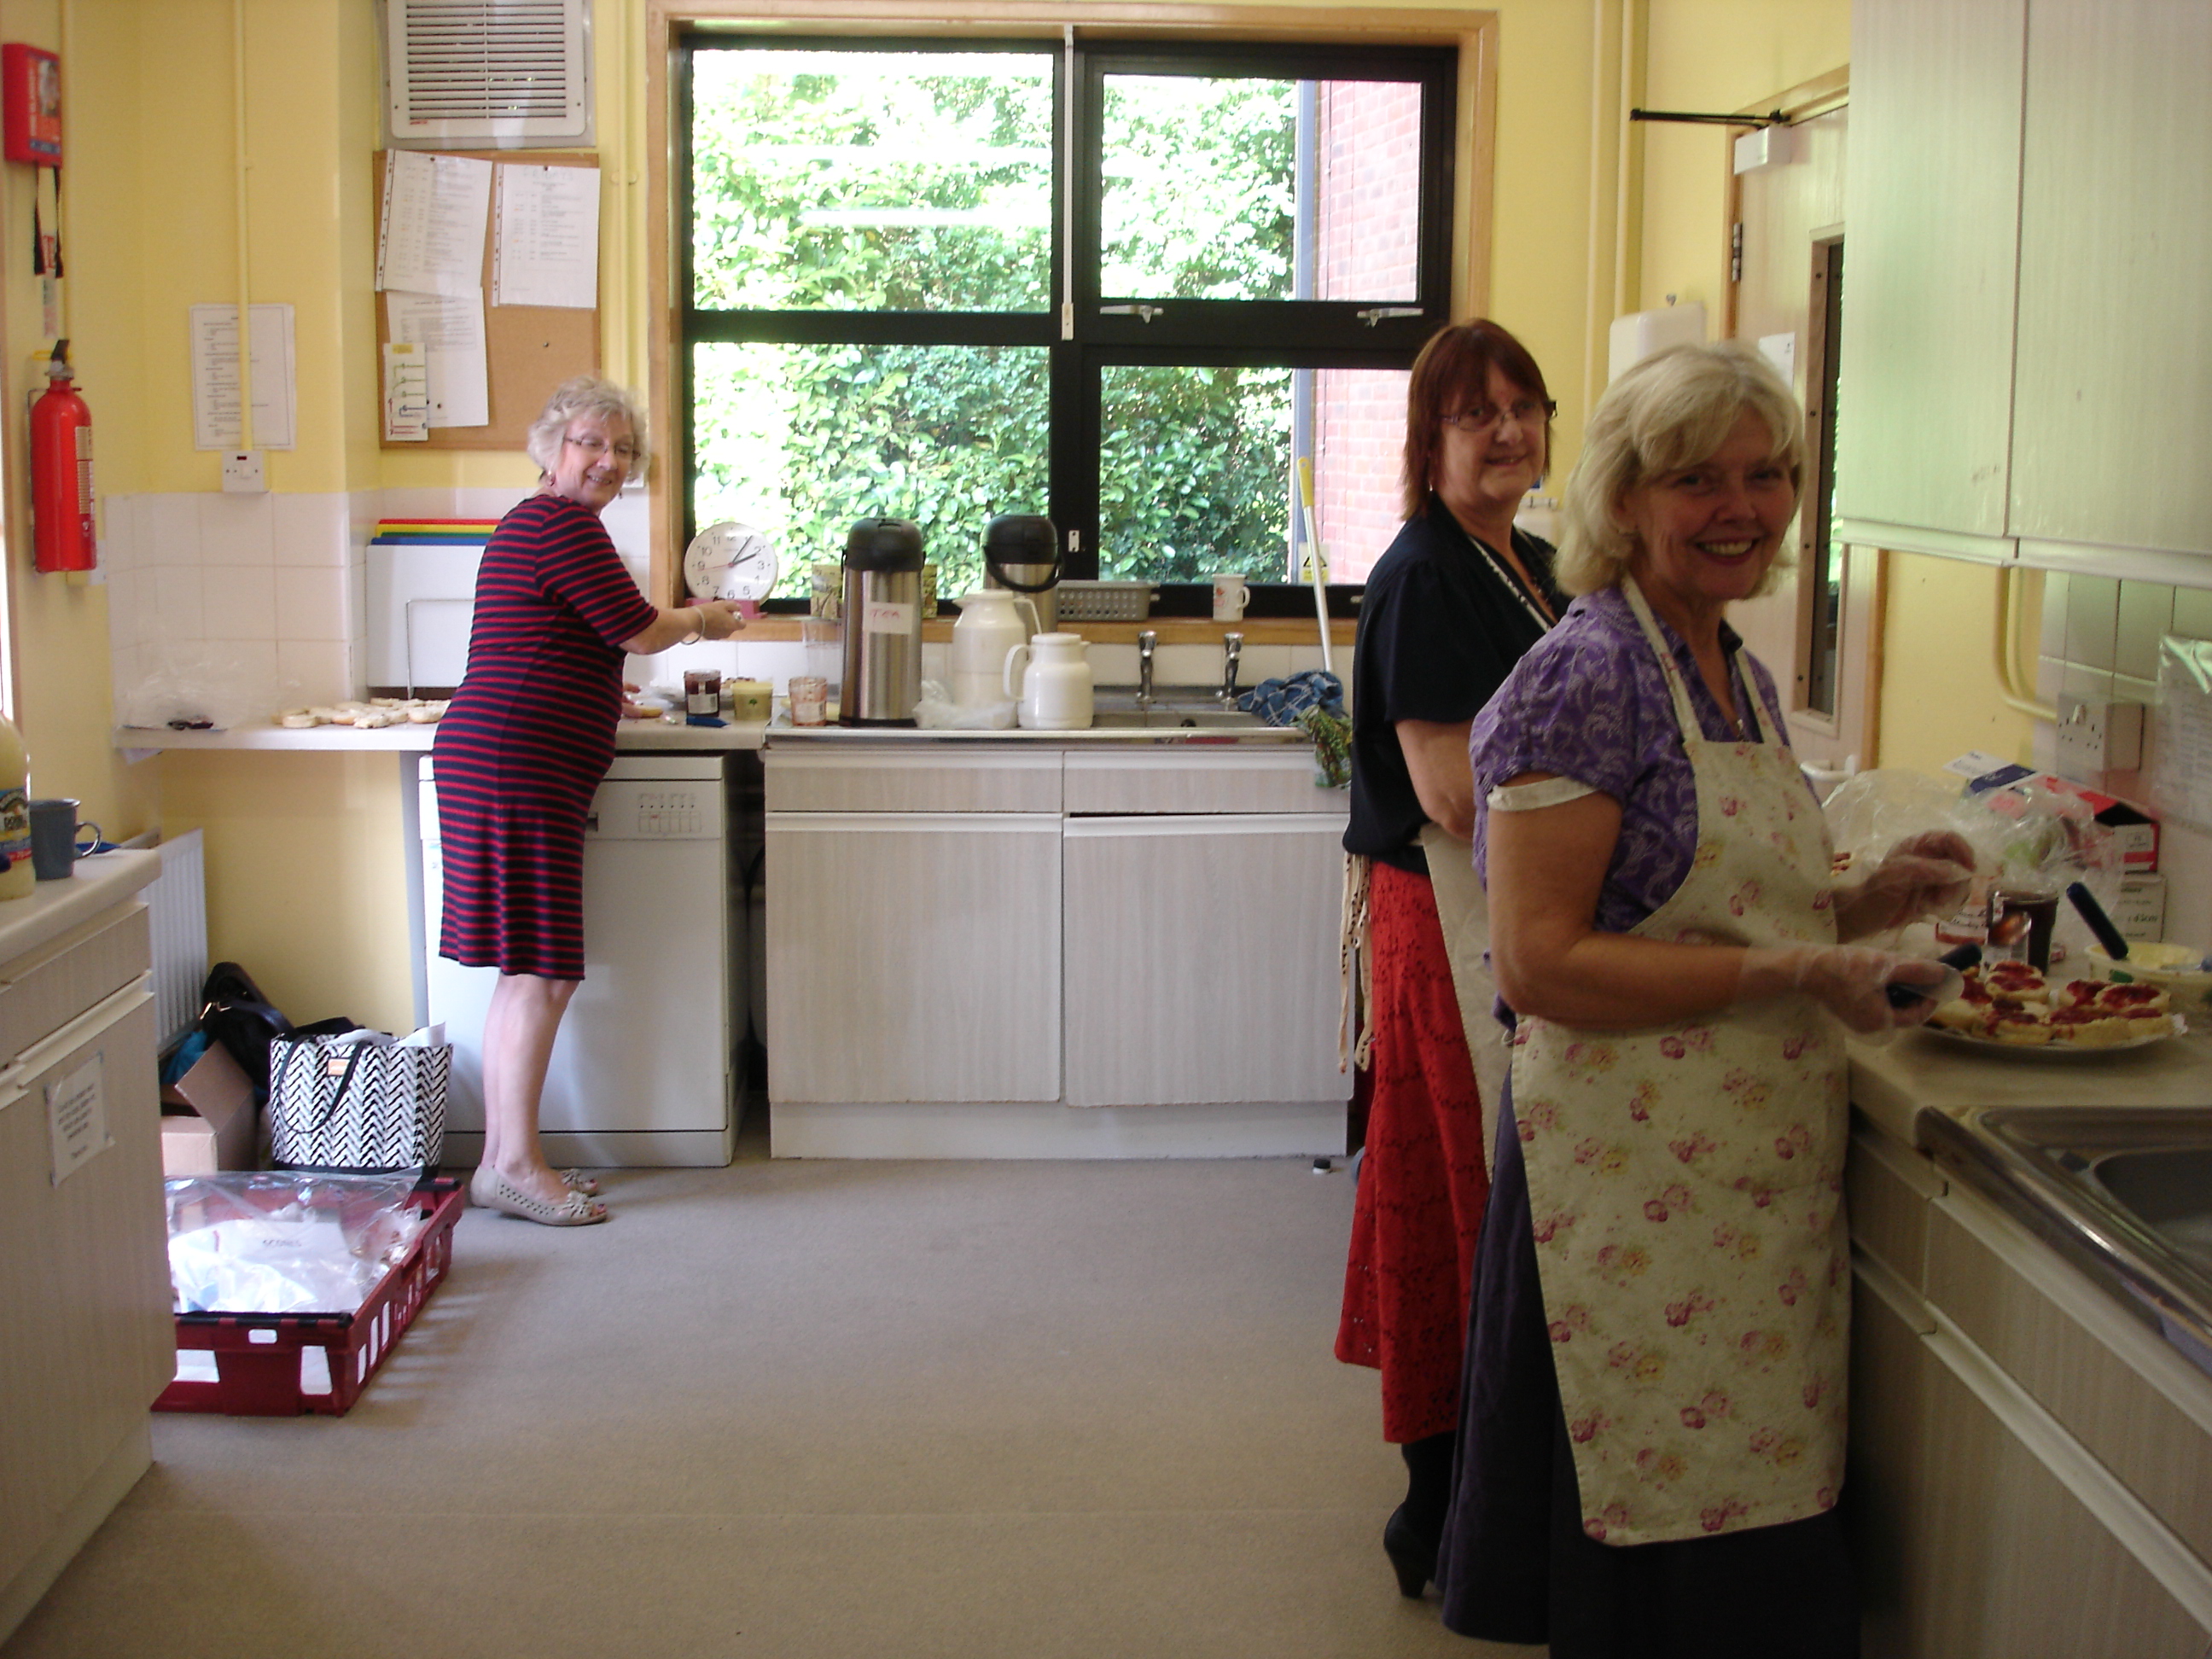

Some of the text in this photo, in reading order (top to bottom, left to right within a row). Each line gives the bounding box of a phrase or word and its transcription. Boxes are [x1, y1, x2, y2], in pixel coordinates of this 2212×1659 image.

[713, 536, 720, 544] 11
[702, 546, 712, 556] 10
[698, 561, 705, 570] 9
[758, 561, 765, 570] 3
[701, 576, 709, 585] 8
[727, 590, 735, 598] 6
[742, 585, 750, 596] 5
